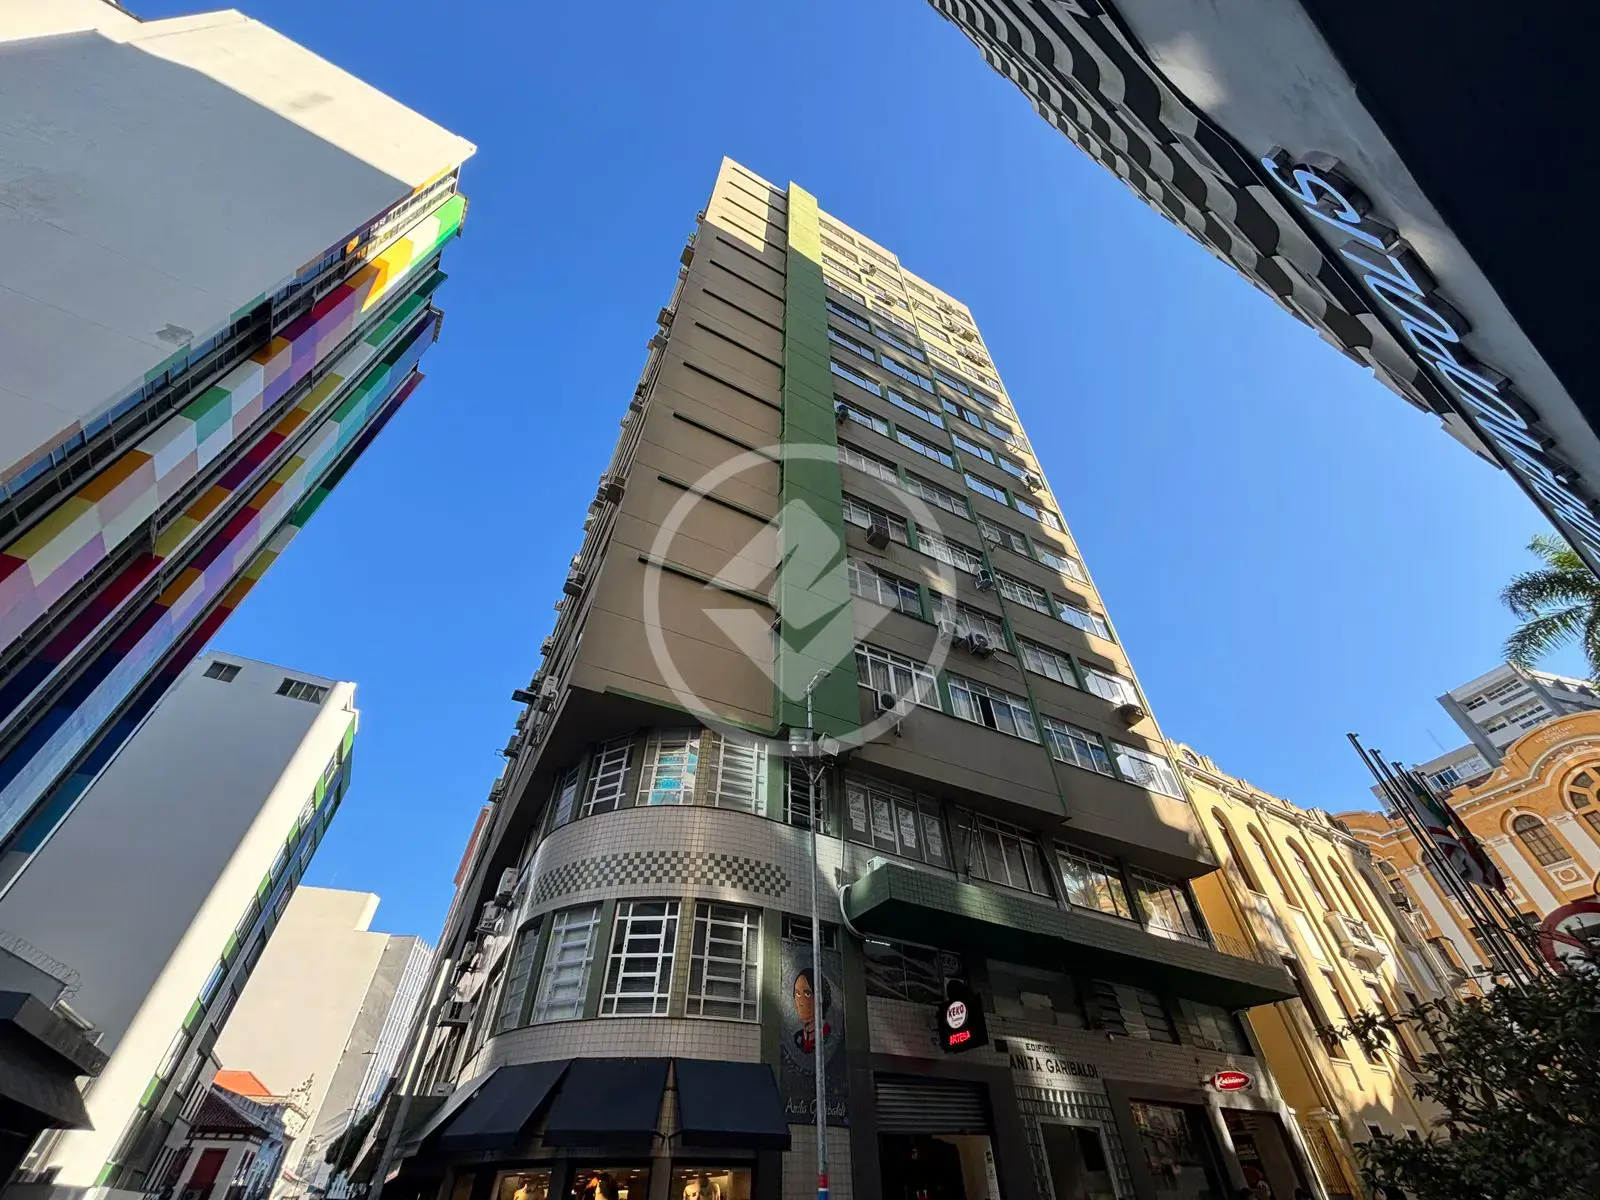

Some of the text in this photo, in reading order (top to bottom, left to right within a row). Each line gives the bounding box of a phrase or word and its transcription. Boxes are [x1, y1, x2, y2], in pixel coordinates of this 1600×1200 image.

[1025, 1043, 1056, 1055] EDIFICIO
[1009, 1055, 1099, 1079] ANITA GARIBALDI
